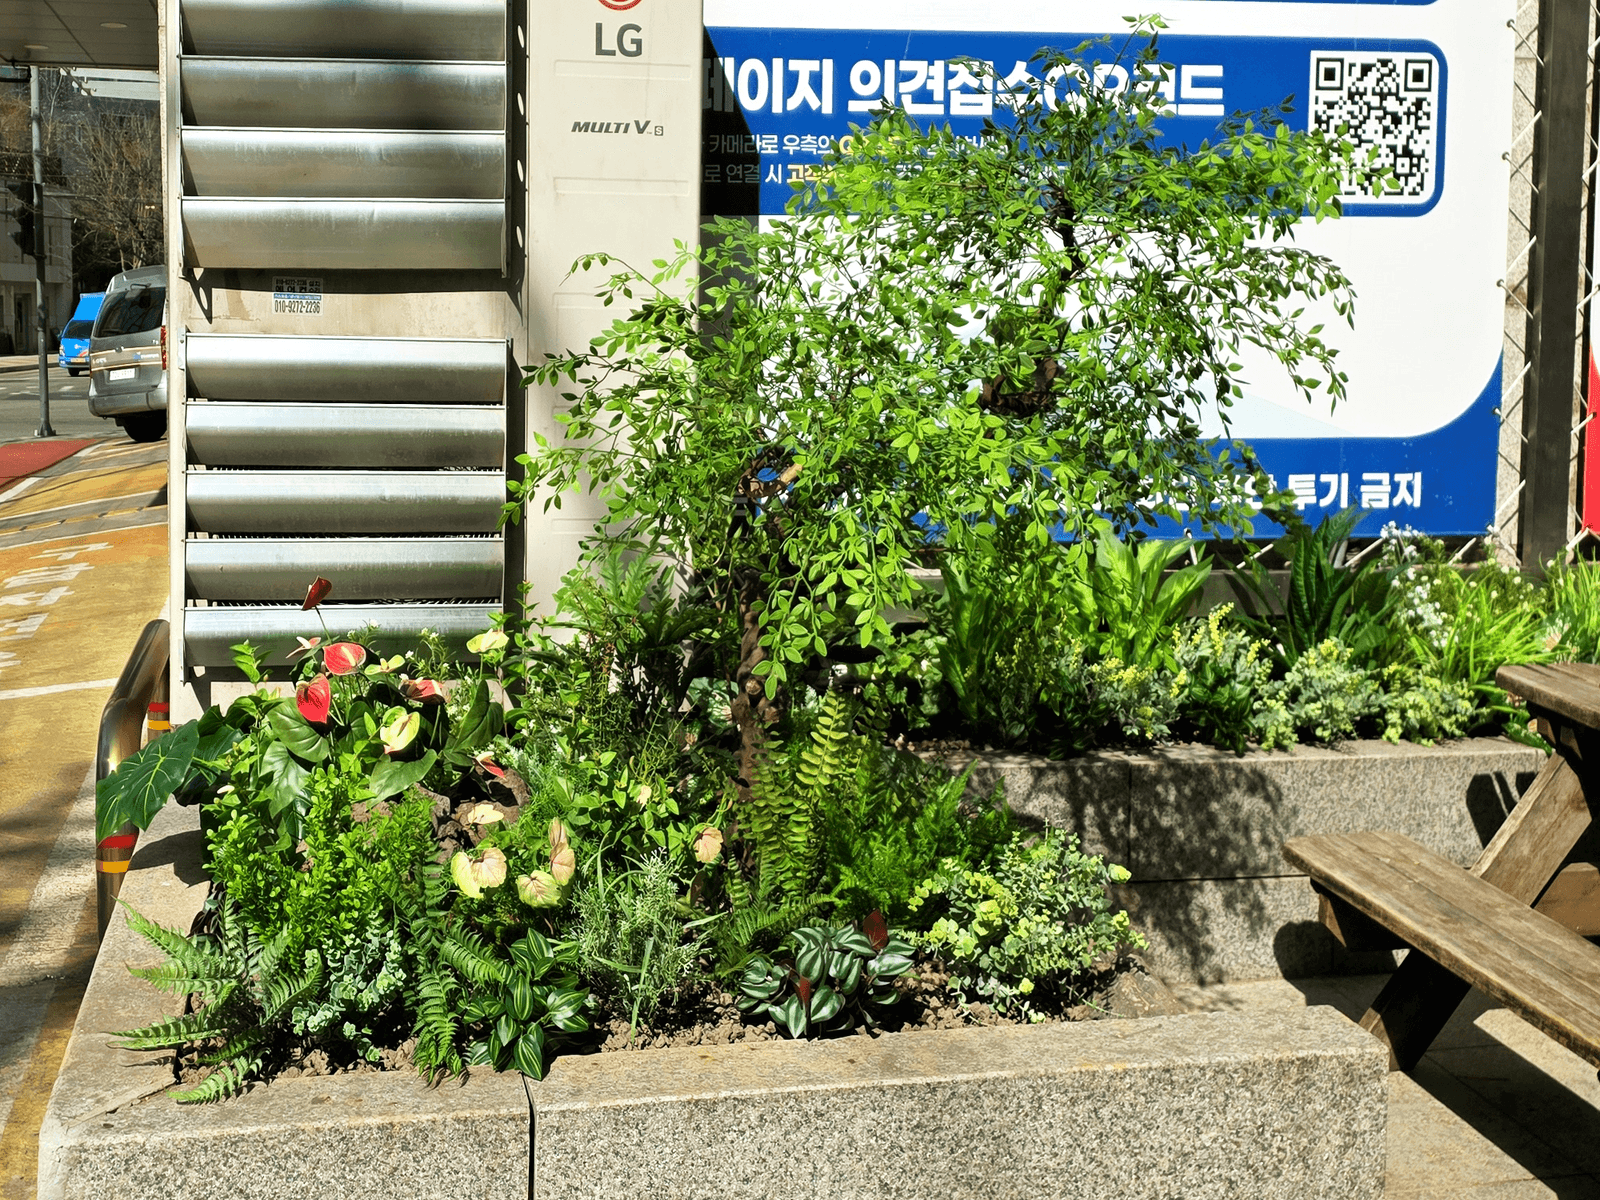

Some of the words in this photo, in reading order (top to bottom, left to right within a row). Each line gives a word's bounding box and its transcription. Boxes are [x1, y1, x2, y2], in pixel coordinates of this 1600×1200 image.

[594, 22, 643, 58] LG
[571, 121, 630, 134] MULTI
[709, 134, 779, 154] 카메라로
[726, 164, 760, 184] 연결
[765, 163, 782, 184] 시
[274, 300, 320, 313] 010-9272-2236
[1287, 473, 1349, 510] 투기
[1360, 472, 1422, 509] 금지
